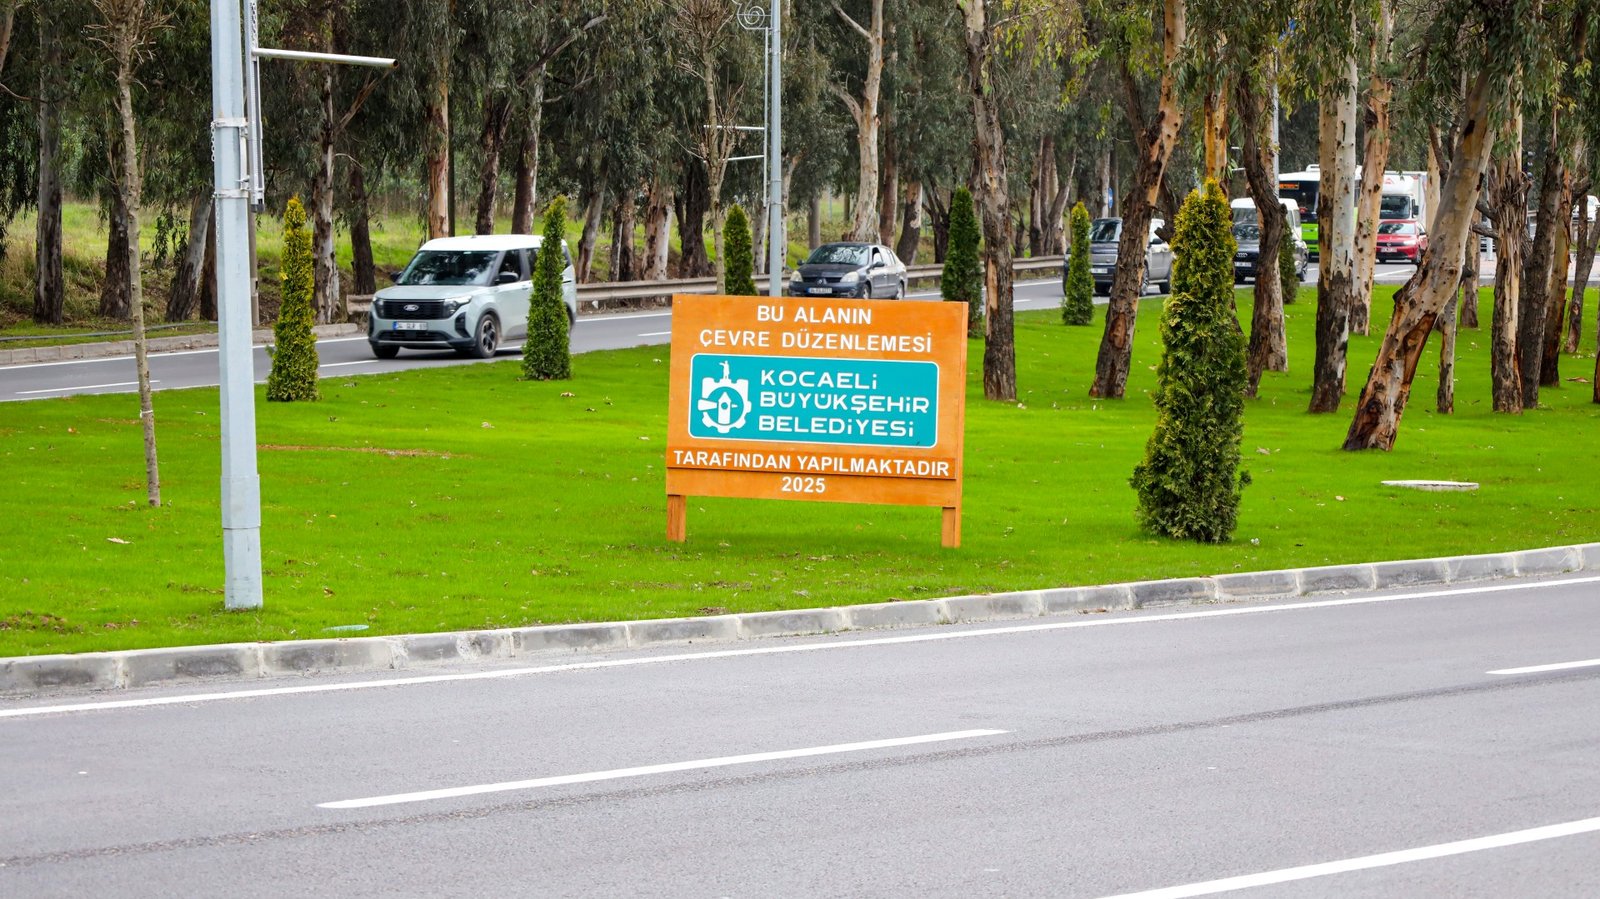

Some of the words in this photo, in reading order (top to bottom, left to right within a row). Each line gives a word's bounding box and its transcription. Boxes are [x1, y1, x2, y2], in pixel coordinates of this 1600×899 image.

[758, 305, 783, 323] BU
[793, 307, 872, 325] ALANIN
[700, 329, 770, 347] ÇEVRE
[781, 328, 932, 353] DÜZENLEMESİ
[673, 450, 791, 468] TARAFINDAN
[796, 455, 949, 476] YAPILMAKTADIR
[781, 476, 826, 493] 2025
